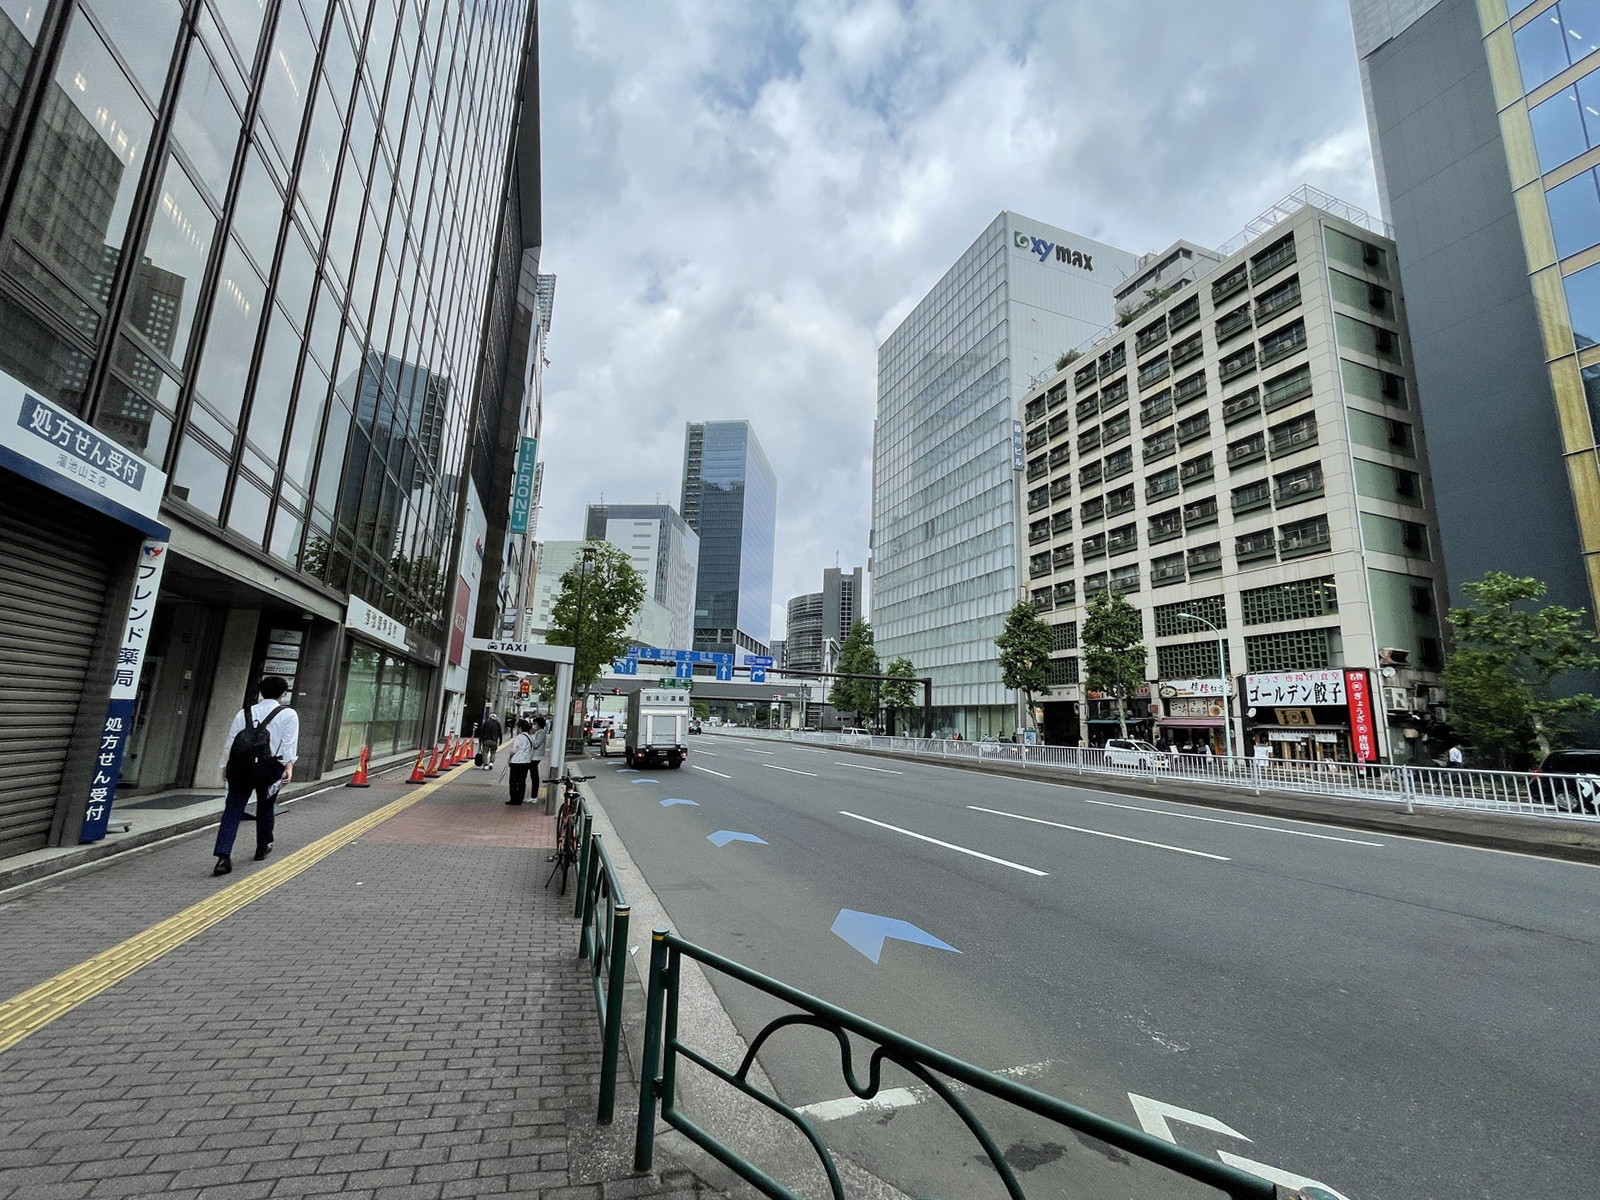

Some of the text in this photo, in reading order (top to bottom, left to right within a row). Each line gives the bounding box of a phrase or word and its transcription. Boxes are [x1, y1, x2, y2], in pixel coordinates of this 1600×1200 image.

[30, 404, 138, 484] 処方せん受付
[56, 453, 108, 488] 溜池山王店
[514, 440, 535, 522] TIFRONT
[113, 564, 157, 688] フレンド薬局
[501, 643, 527, 652] TAXI
[1249, 682, 1341, 704] ゴールデン餃子
[85, 717, 122, 821] 処方せん受付
